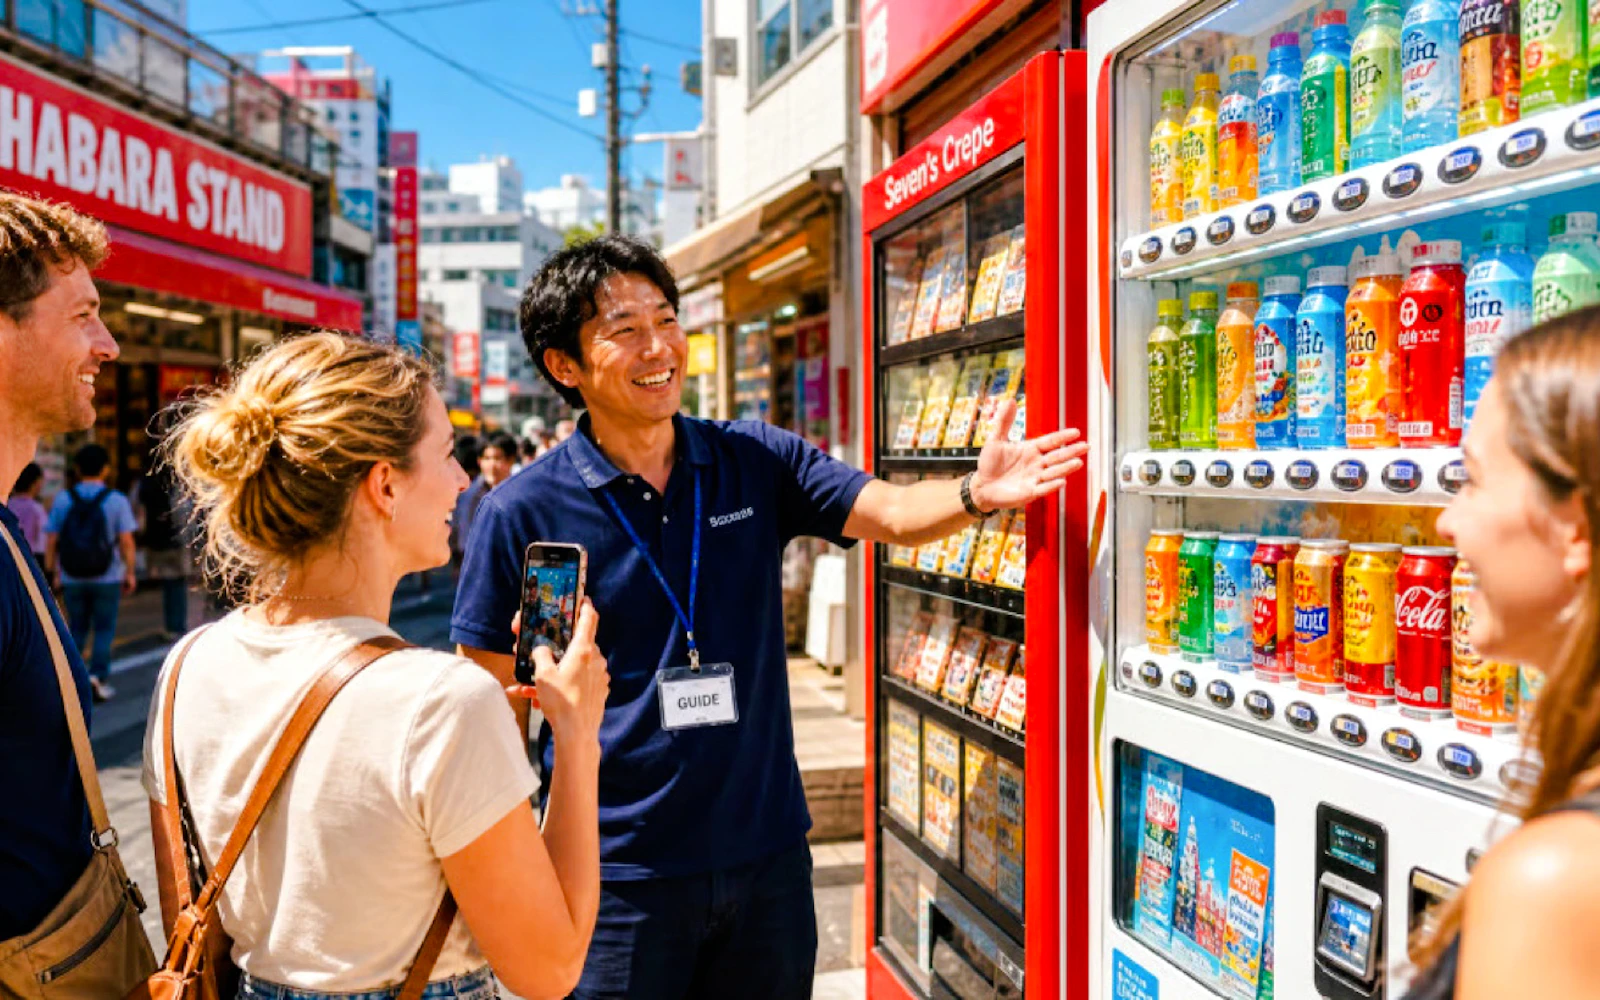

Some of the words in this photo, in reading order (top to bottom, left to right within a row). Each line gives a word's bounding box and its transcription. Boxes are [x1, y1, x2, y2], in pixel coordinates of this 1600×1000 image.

[0, 85, 178, 223] HABARA
[186, 160, 285, 252] STAND
[884, 151, 938, 210] Seven's
[942, 117, 995, 172] Crepe
[677, 693, 720, 711] GUIDE
